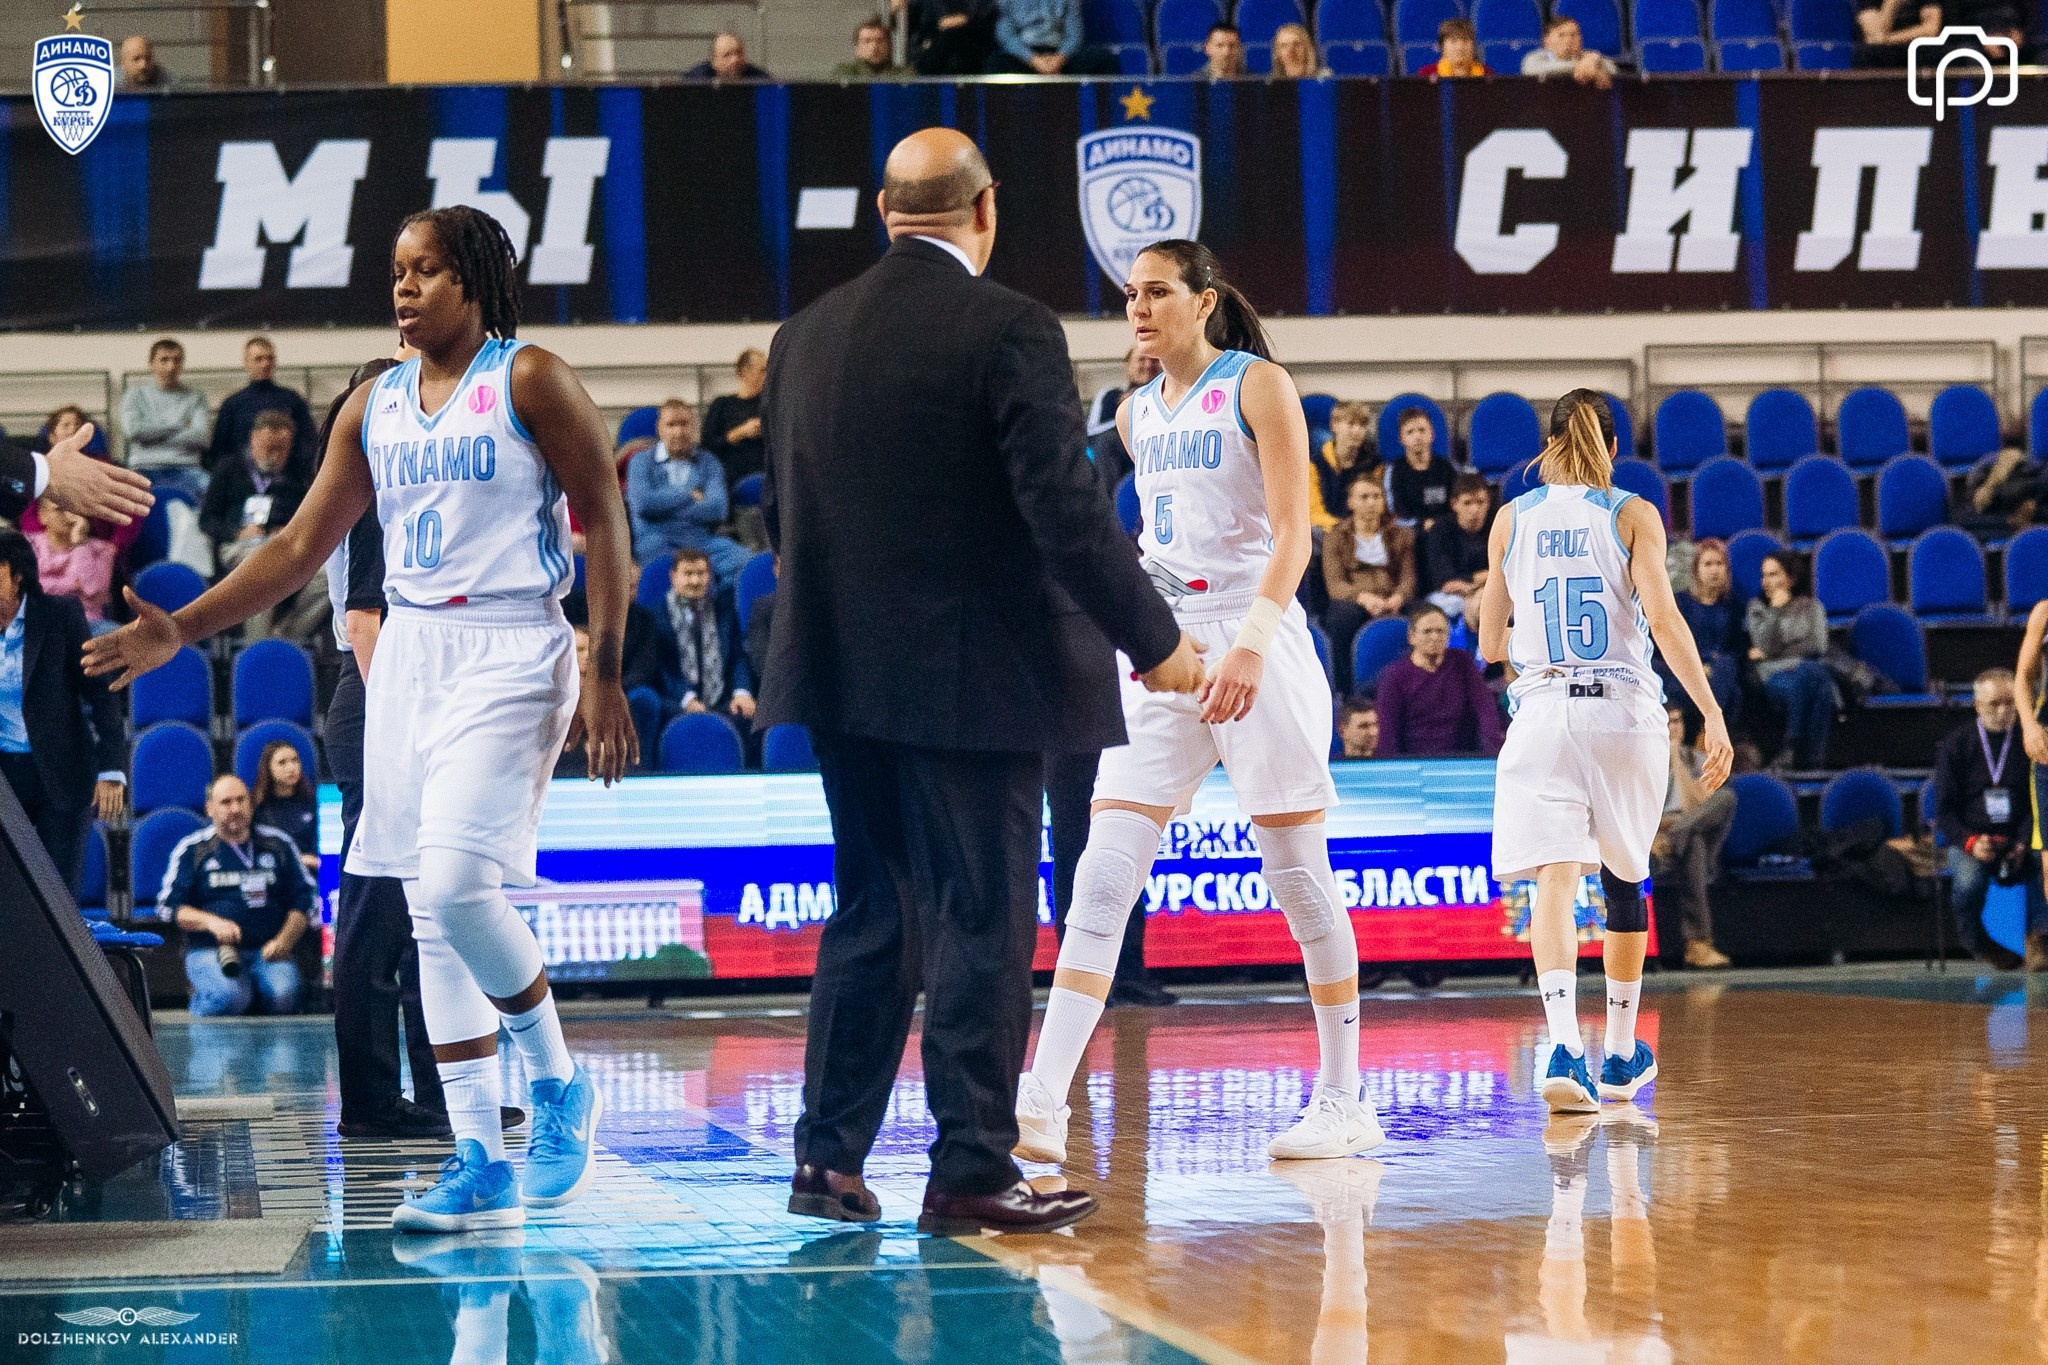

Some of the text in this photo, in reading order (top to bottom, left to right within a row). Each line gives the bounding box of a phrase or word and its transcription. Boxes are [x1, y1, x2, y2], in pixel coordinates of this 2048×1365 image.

[1135, 429, 1223, 477] YNAMO
[402, 509, 443, 569] 10
[1154, 494, 1174, 546] 5
[1536, 527, 1590, 558] CRUZ
[1533, 576, 1609, 664] 15
[1333, 865, 1490, 907] БЛАСТИ
